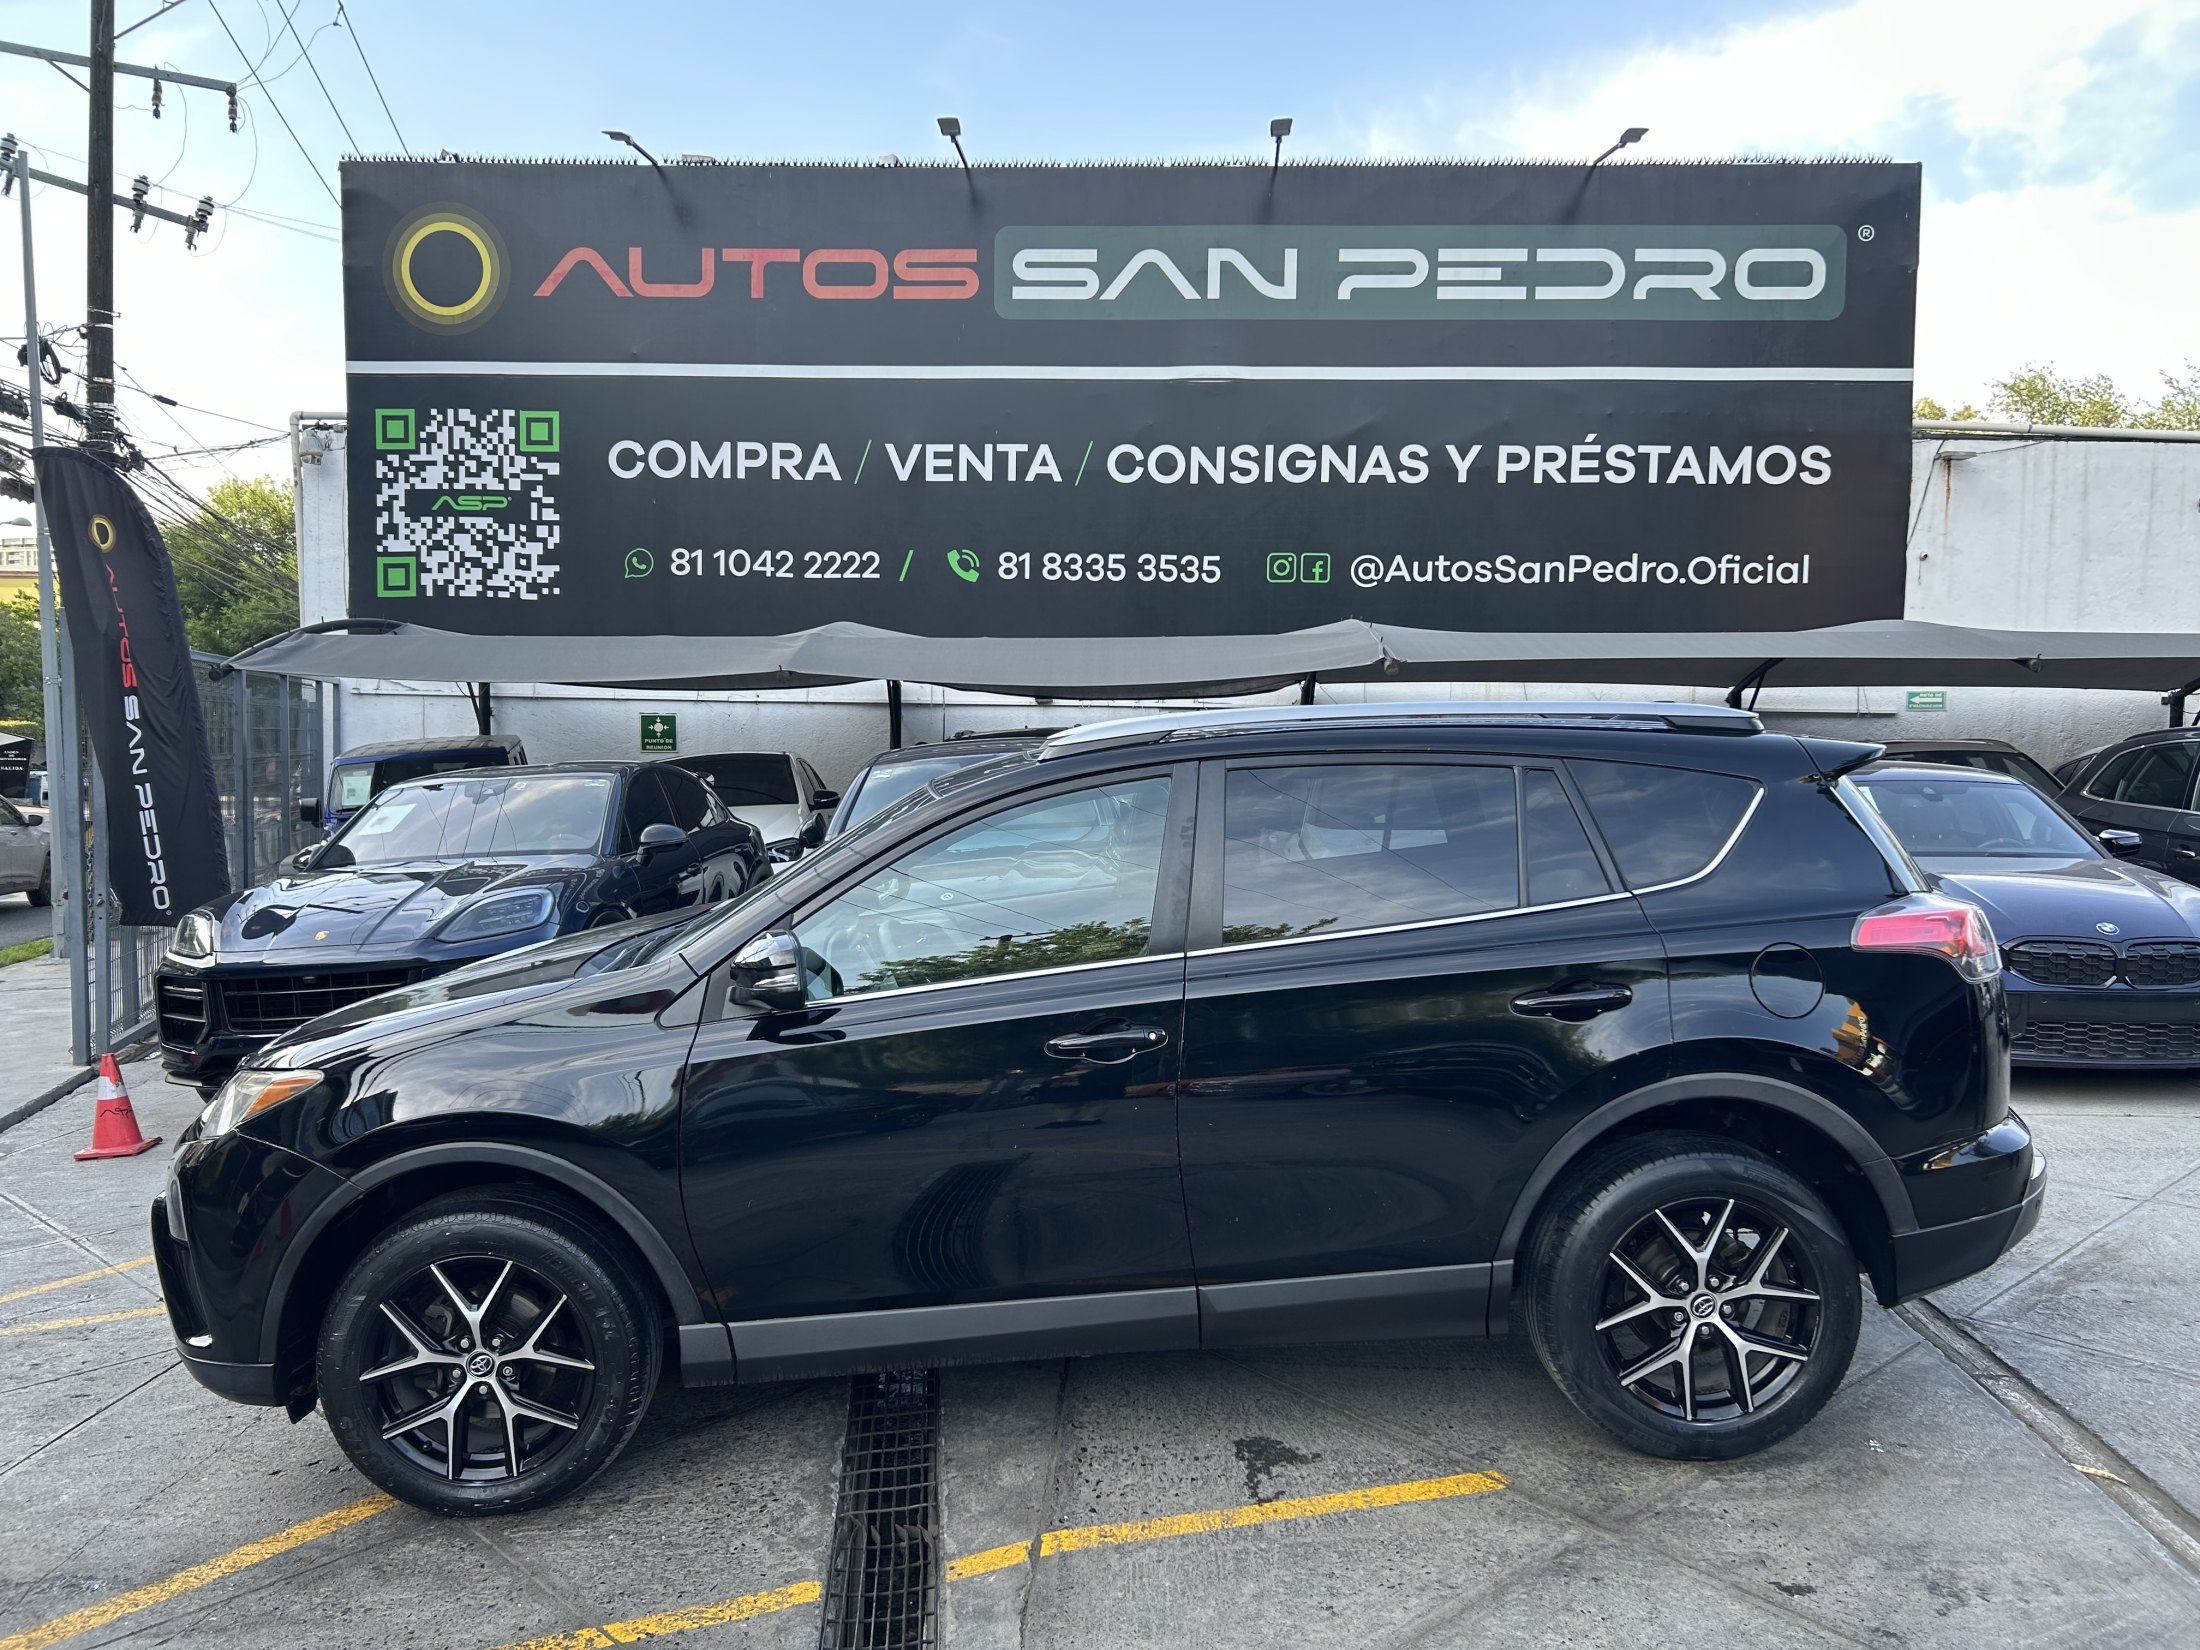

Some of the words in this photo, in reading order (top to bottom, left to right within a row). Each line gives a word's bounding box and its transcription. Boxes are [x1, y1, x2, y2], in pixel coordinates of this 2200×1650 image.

[534, 246, 980, 300] AUTOS
[1011, 247, 1298, 301] SAN
[1337, 247, 1827, 301] PEDRO
[607, 439, 842, 482] COMPRA
[885, 443, 1063, 482] VENTA
[1106, 443, 1430, 485] CONSIGNAS
[1444, 444, 1483, 483] Y
[1497, 434, 1832, 486] PRÉSTAMOS
[431, 495, 508, 511] ASP
[670, 547, 704, 577] 81
[713, 548, 794, 579] 1042
[803, 550, 881, 580] 2222
[997, 551, 1031, 580] 81
[1041, 552, 1127, 582] 8335
[1137, 553, 1221, 584] 3535
[1349, 552, 1810, 588] @AutosSanPedro.Oficial
[105, 562, 138, 688] ATOS
[124, 694, 148, 776] SAN
[134, 782, 171, 911] PEDRO
